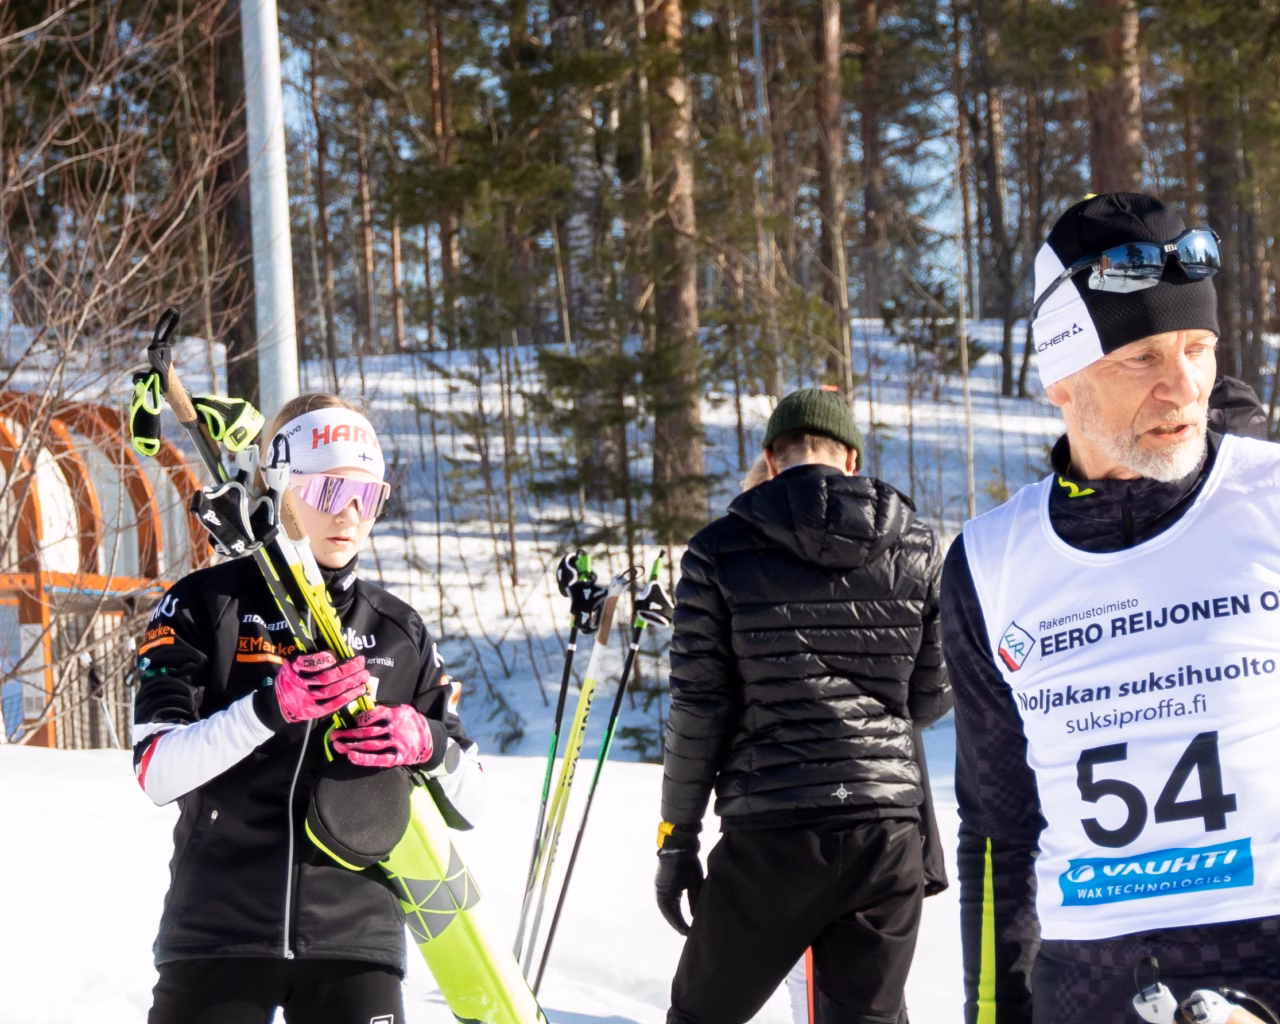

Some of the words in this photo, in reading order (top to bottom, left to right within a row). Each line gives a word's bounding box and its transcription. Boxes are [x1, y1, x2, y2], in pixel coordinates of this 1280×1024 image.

[1038, 598, 1140, 632] Rakennustoimisto
[1040, 623, 1102, 660] EERO
[1110, 594, 1251, 639] REIJONEN
[1017, 684, 1113, 714] Noljakan
[1118, 655, 1277, 699] suksihuolto
[1065, 694, 1208, 735] suksiproffa.fi
[1076, 730, 1238, 849] 54
[1102, 848, 1238, 877] VAUHTI
[1077, 886, 1103, 899] WAX
[1107, 872, 1233, 898] TECHNOLOGIES
